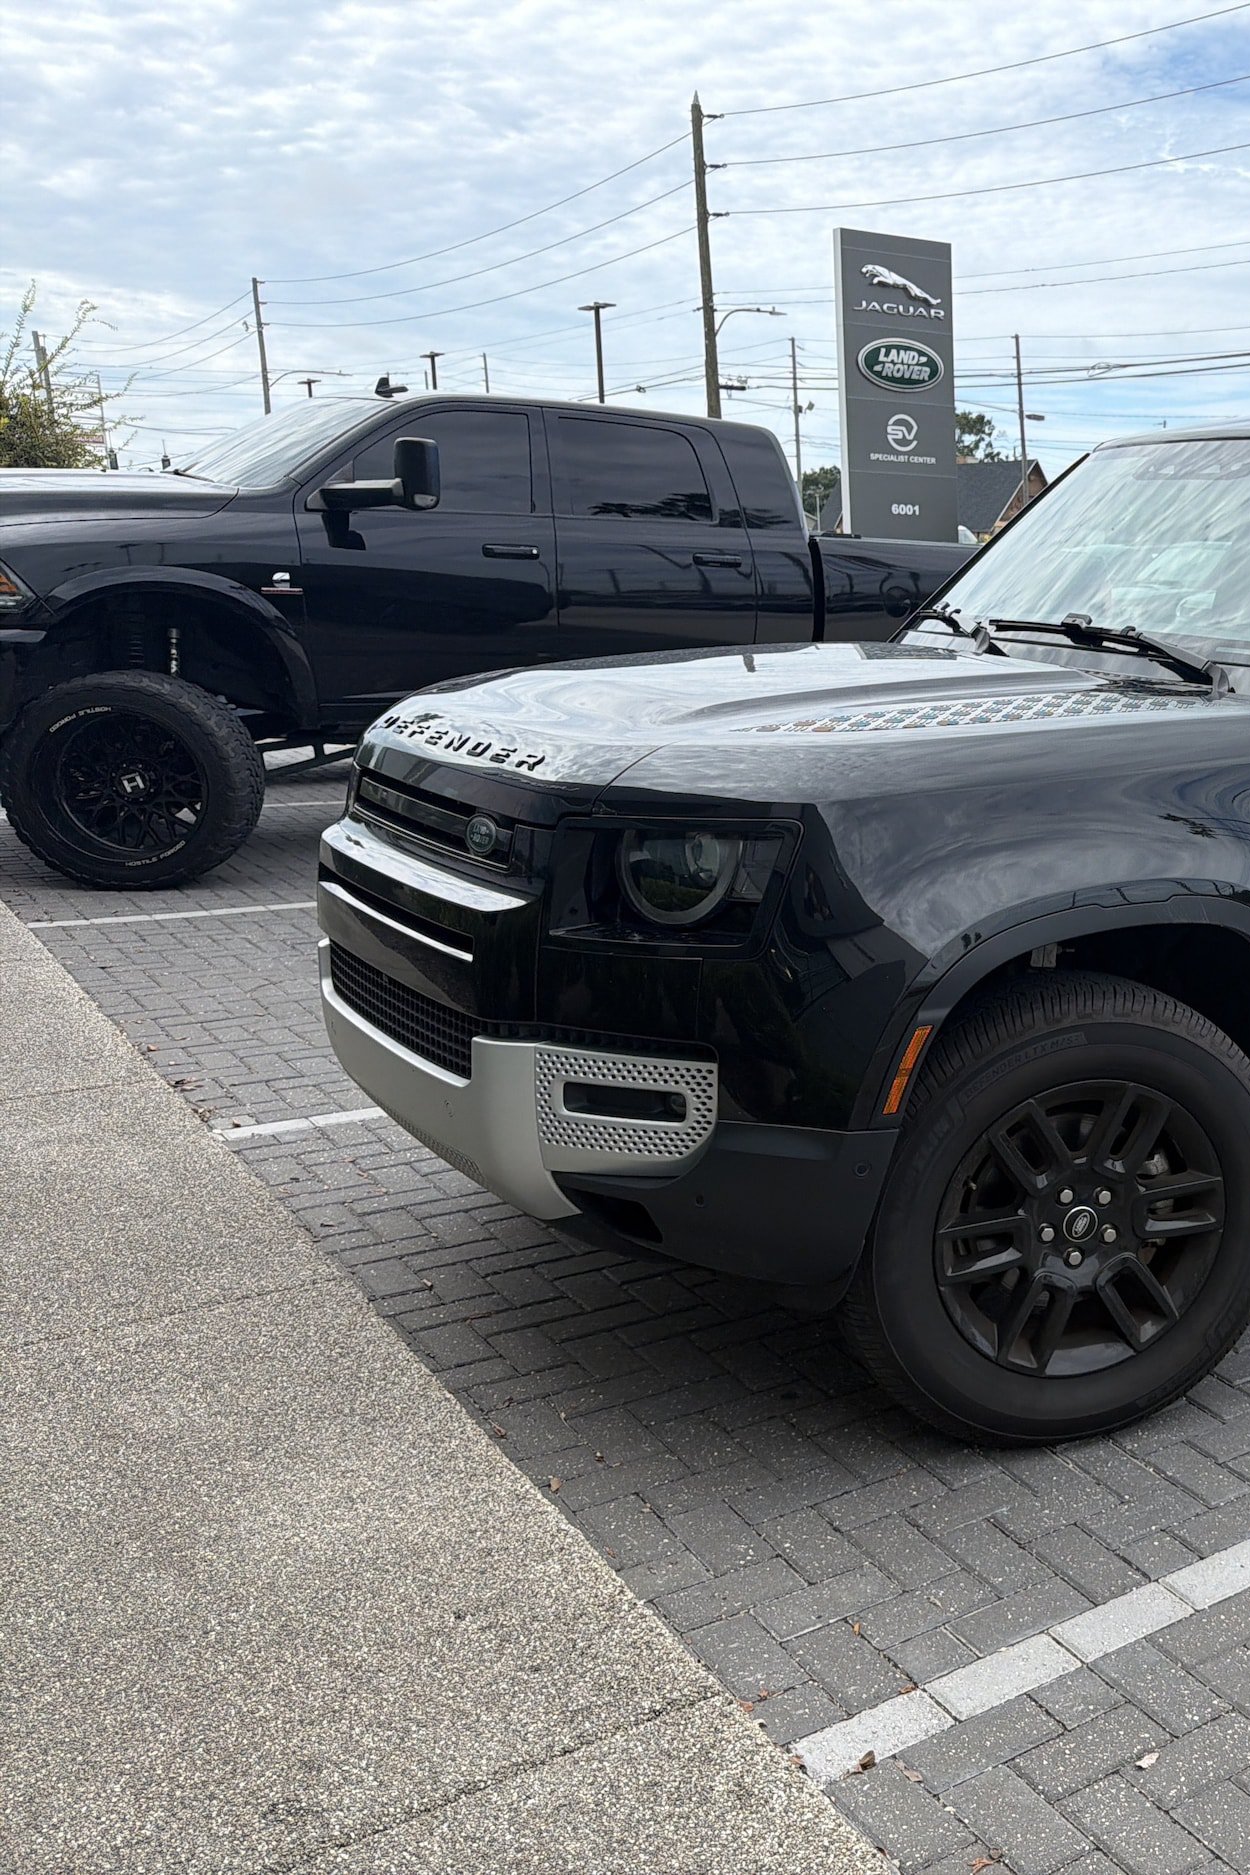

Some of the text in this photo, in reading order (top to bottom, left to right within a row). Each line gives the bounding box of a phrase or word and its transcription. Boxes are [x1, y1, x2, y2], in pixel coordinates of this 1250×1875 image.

[853, 300, 945, 320] JAGUAR
[878, 347, 919, 365] LAND
[881, 363, 931, 381] ROVER
[870, 453, 937, 464] SPECIALIST CENTER
[891, 504, 920, 516] 6001
[383, 715, 546, 772] DEFENDER
